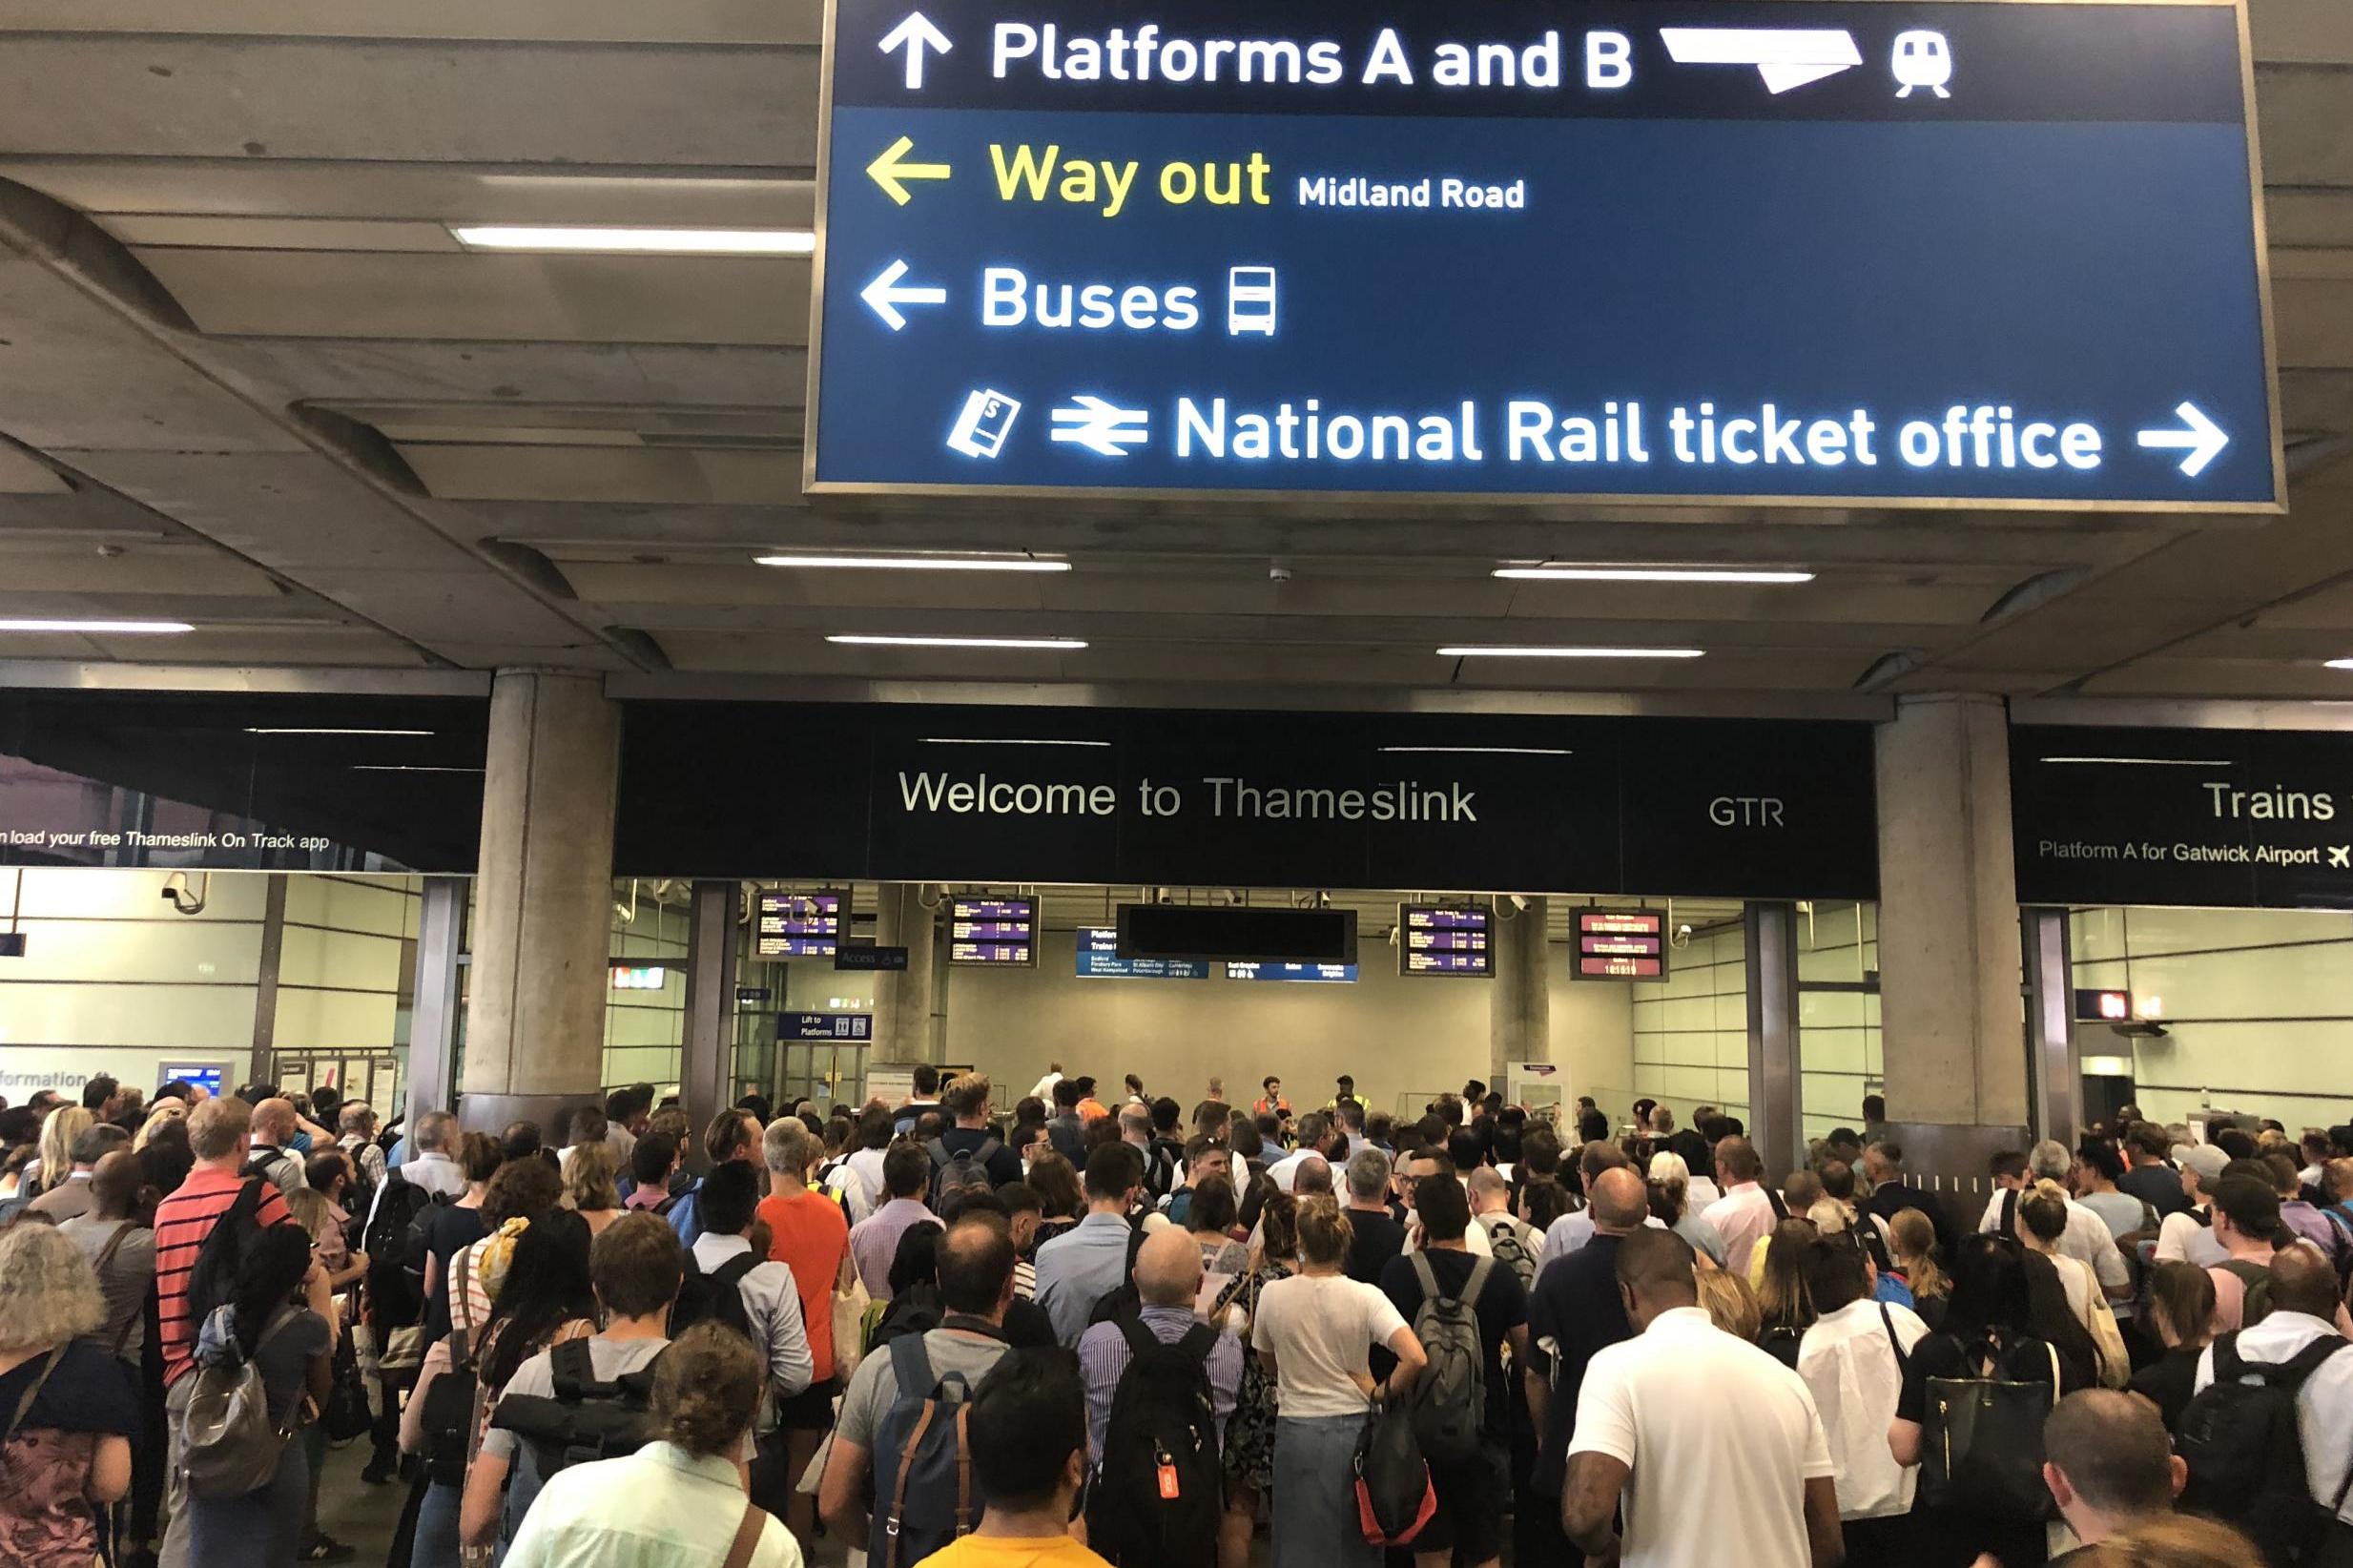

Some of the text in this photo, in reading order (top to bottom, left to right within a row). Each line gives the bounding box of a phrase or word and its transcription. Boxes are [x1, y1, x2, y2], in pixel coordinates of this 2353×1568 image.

[994, 24, 1633, 89] Platforms A and B
[990, 145, 1271, 218] Way out
[1297, 177, 1526, 210] Midland Road
[981, 268, 1200, 331] Buses
[1175, 398, 2104, 471] National Rail ticket office
[898, 772, 1478, 823] Welcome to Thameslink
[1709, 796, 1785, 827] GTR
[2202, 782, 2336, 822] Trains
[49, 833, 87, 848] your
[90, 831, 120, 845] free
[126, 831, 217, 847] Thameslink
[221, 832, 245, 848] On
[252, 833, 295, 849] Track
[299, 836, 330, 851] app
[2039, 839, 2321, 868] Platform A for Gatwick Airport
[800, 1027, 833, 1037] Platforms
[801, 1016, 821, 1024] Lift to
